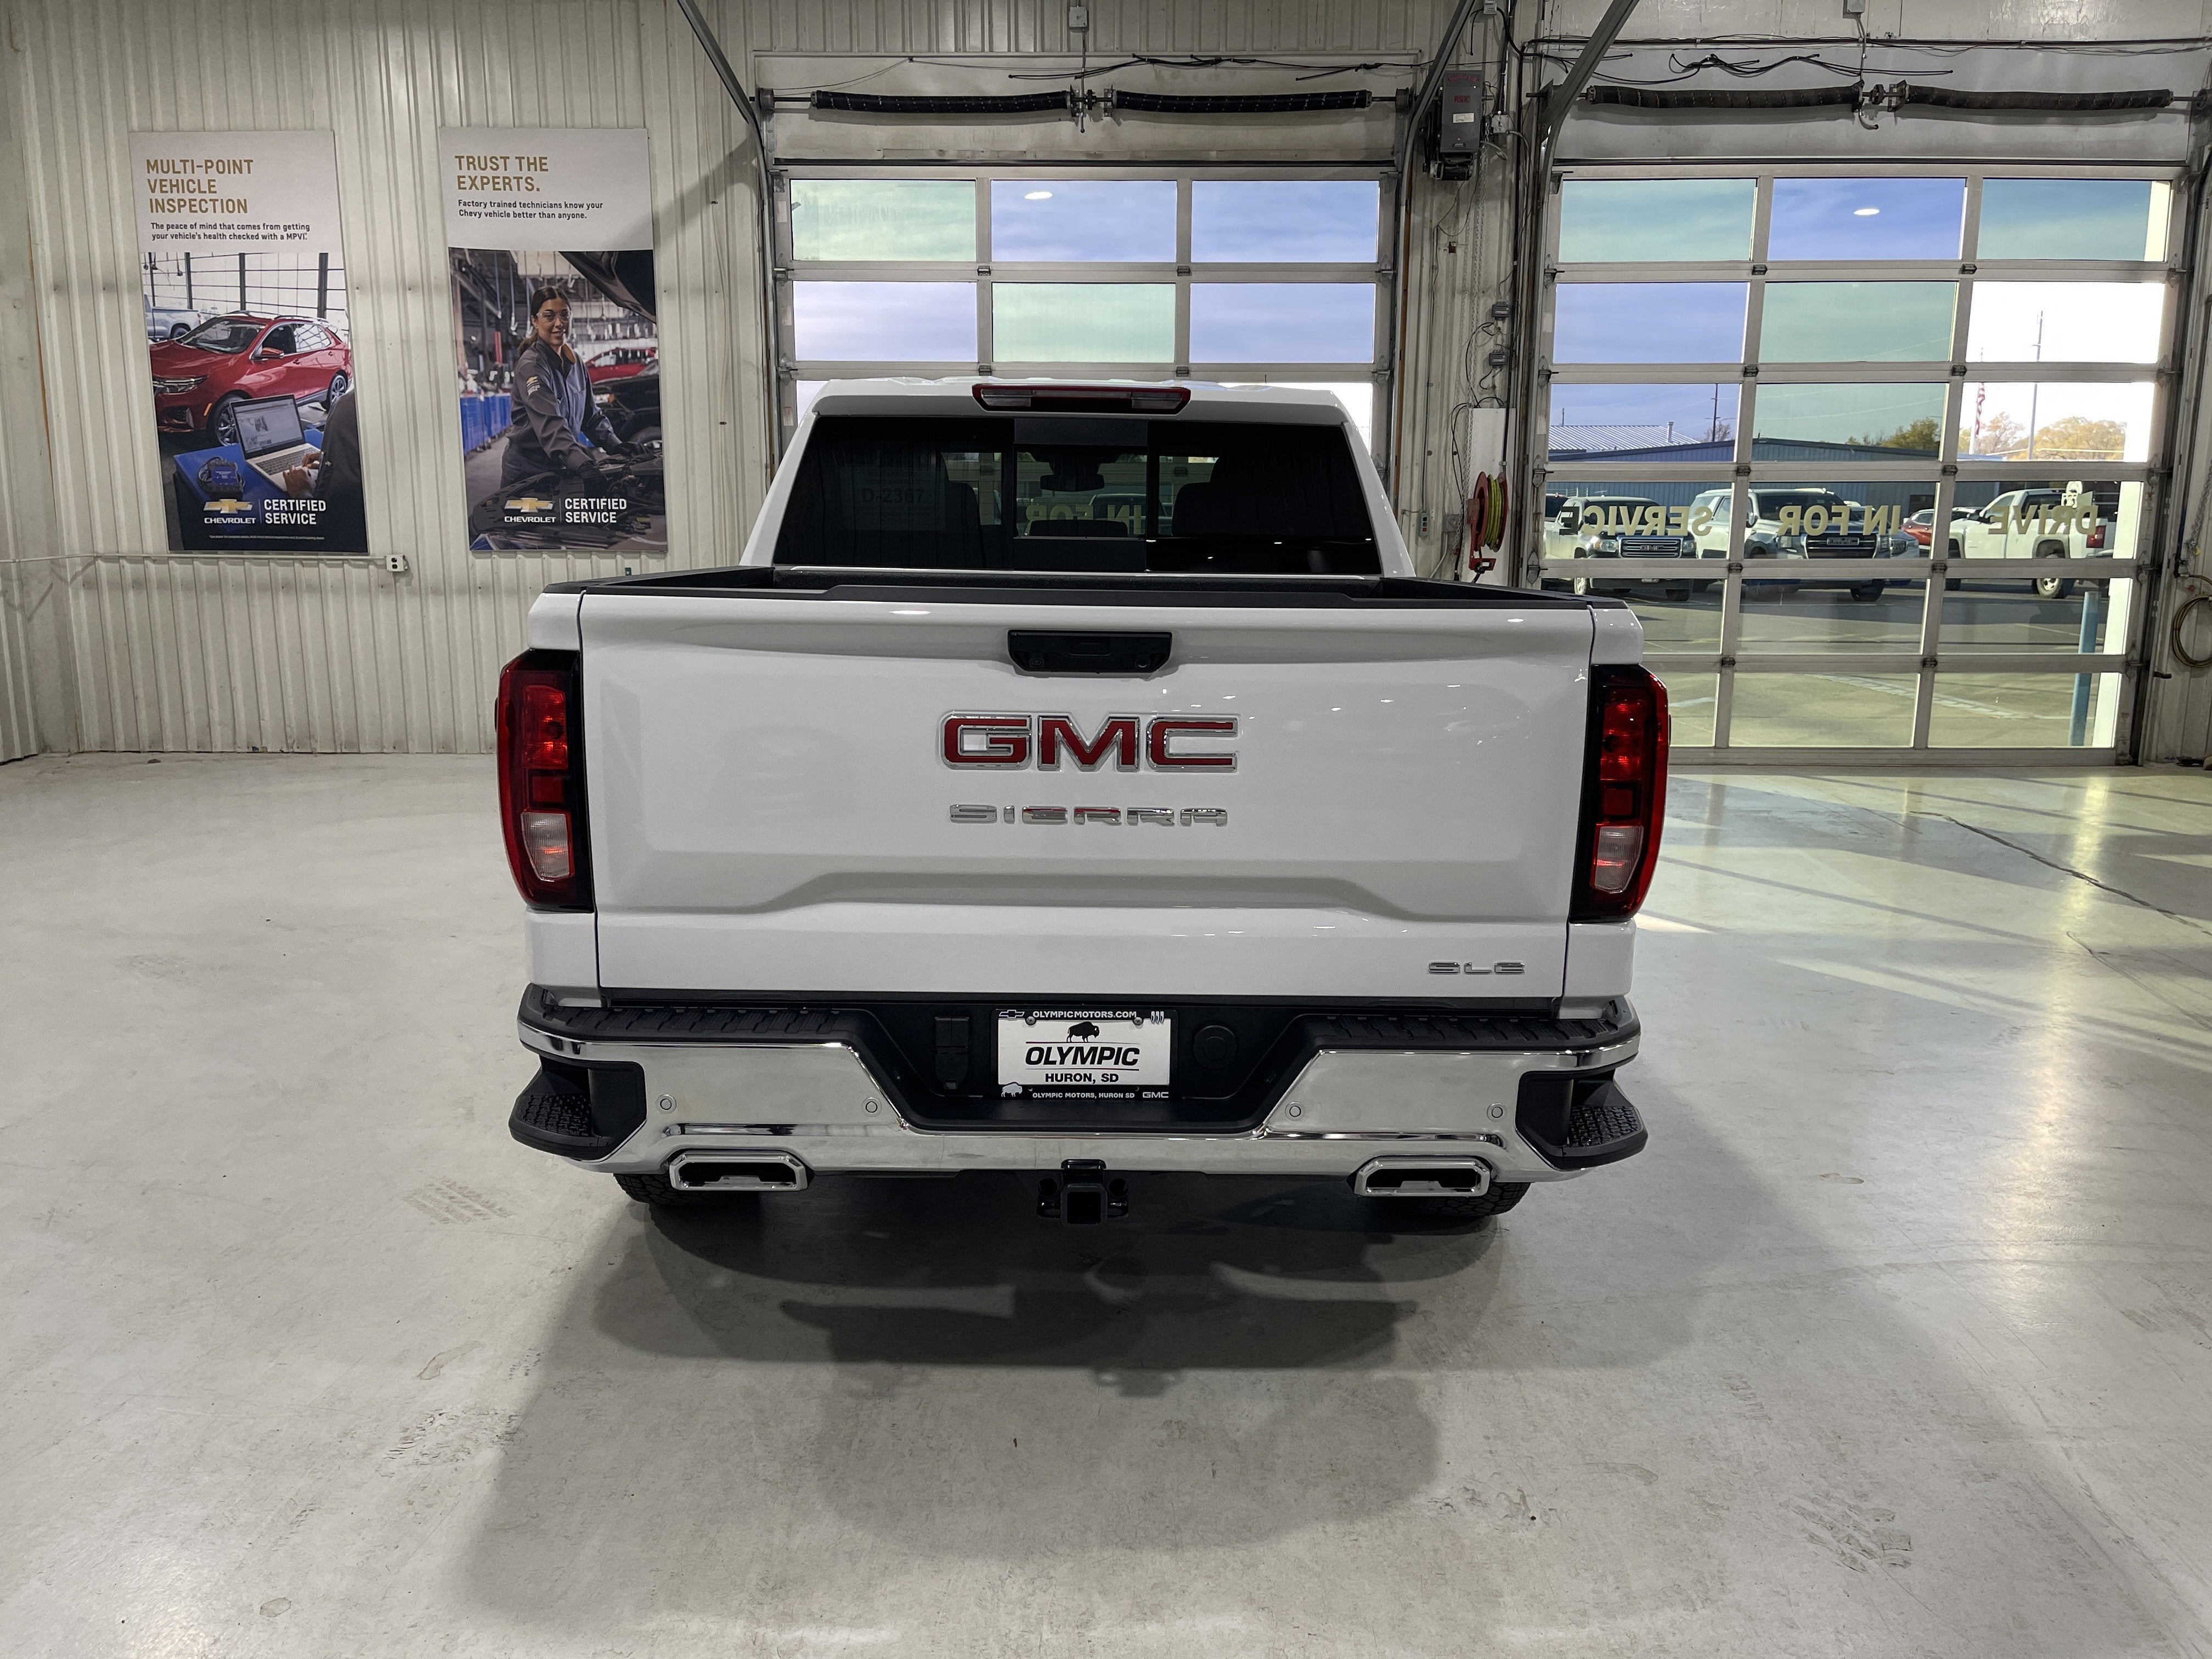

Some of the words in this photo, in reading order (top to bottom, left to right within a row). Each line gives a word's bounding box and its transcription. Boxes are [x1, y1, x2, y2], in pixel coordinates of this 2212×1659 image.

[146, 159, 253, 174] MULTI-POINT
[455, 156, 510, 171] TRUST
[515, 156, 549, 172] THE
[147, 179, 217, 194] VEHICLE
[457, 176, 540, 191] EXPERTS.
[149, 198, 247, 213] INSPECTION
[458, 200, 487, 208] Factory
[459, 209, 482, 218] Chevy
[283, 223, 310, 232] getting
[862, 488, 924, 503] D-2367
[263, 499, 326, 512] CERTIFIED
[565, 498, 627, 510] CERTIFIED
[265, 513, 317, 524] SERVICE
[565, 512, 617, 523] SERVICE
[940, 710, 1238, 772] GMC
[949, 804, 1228, 826] SIERRA
[1429, 962, 1525, 975] SLE
[1025, 1046, 1140, 1066] OLYMPIC
[1045, 1073, 1096, 1084] HURON,
[1101, 1073, 1119, 1082] SD
